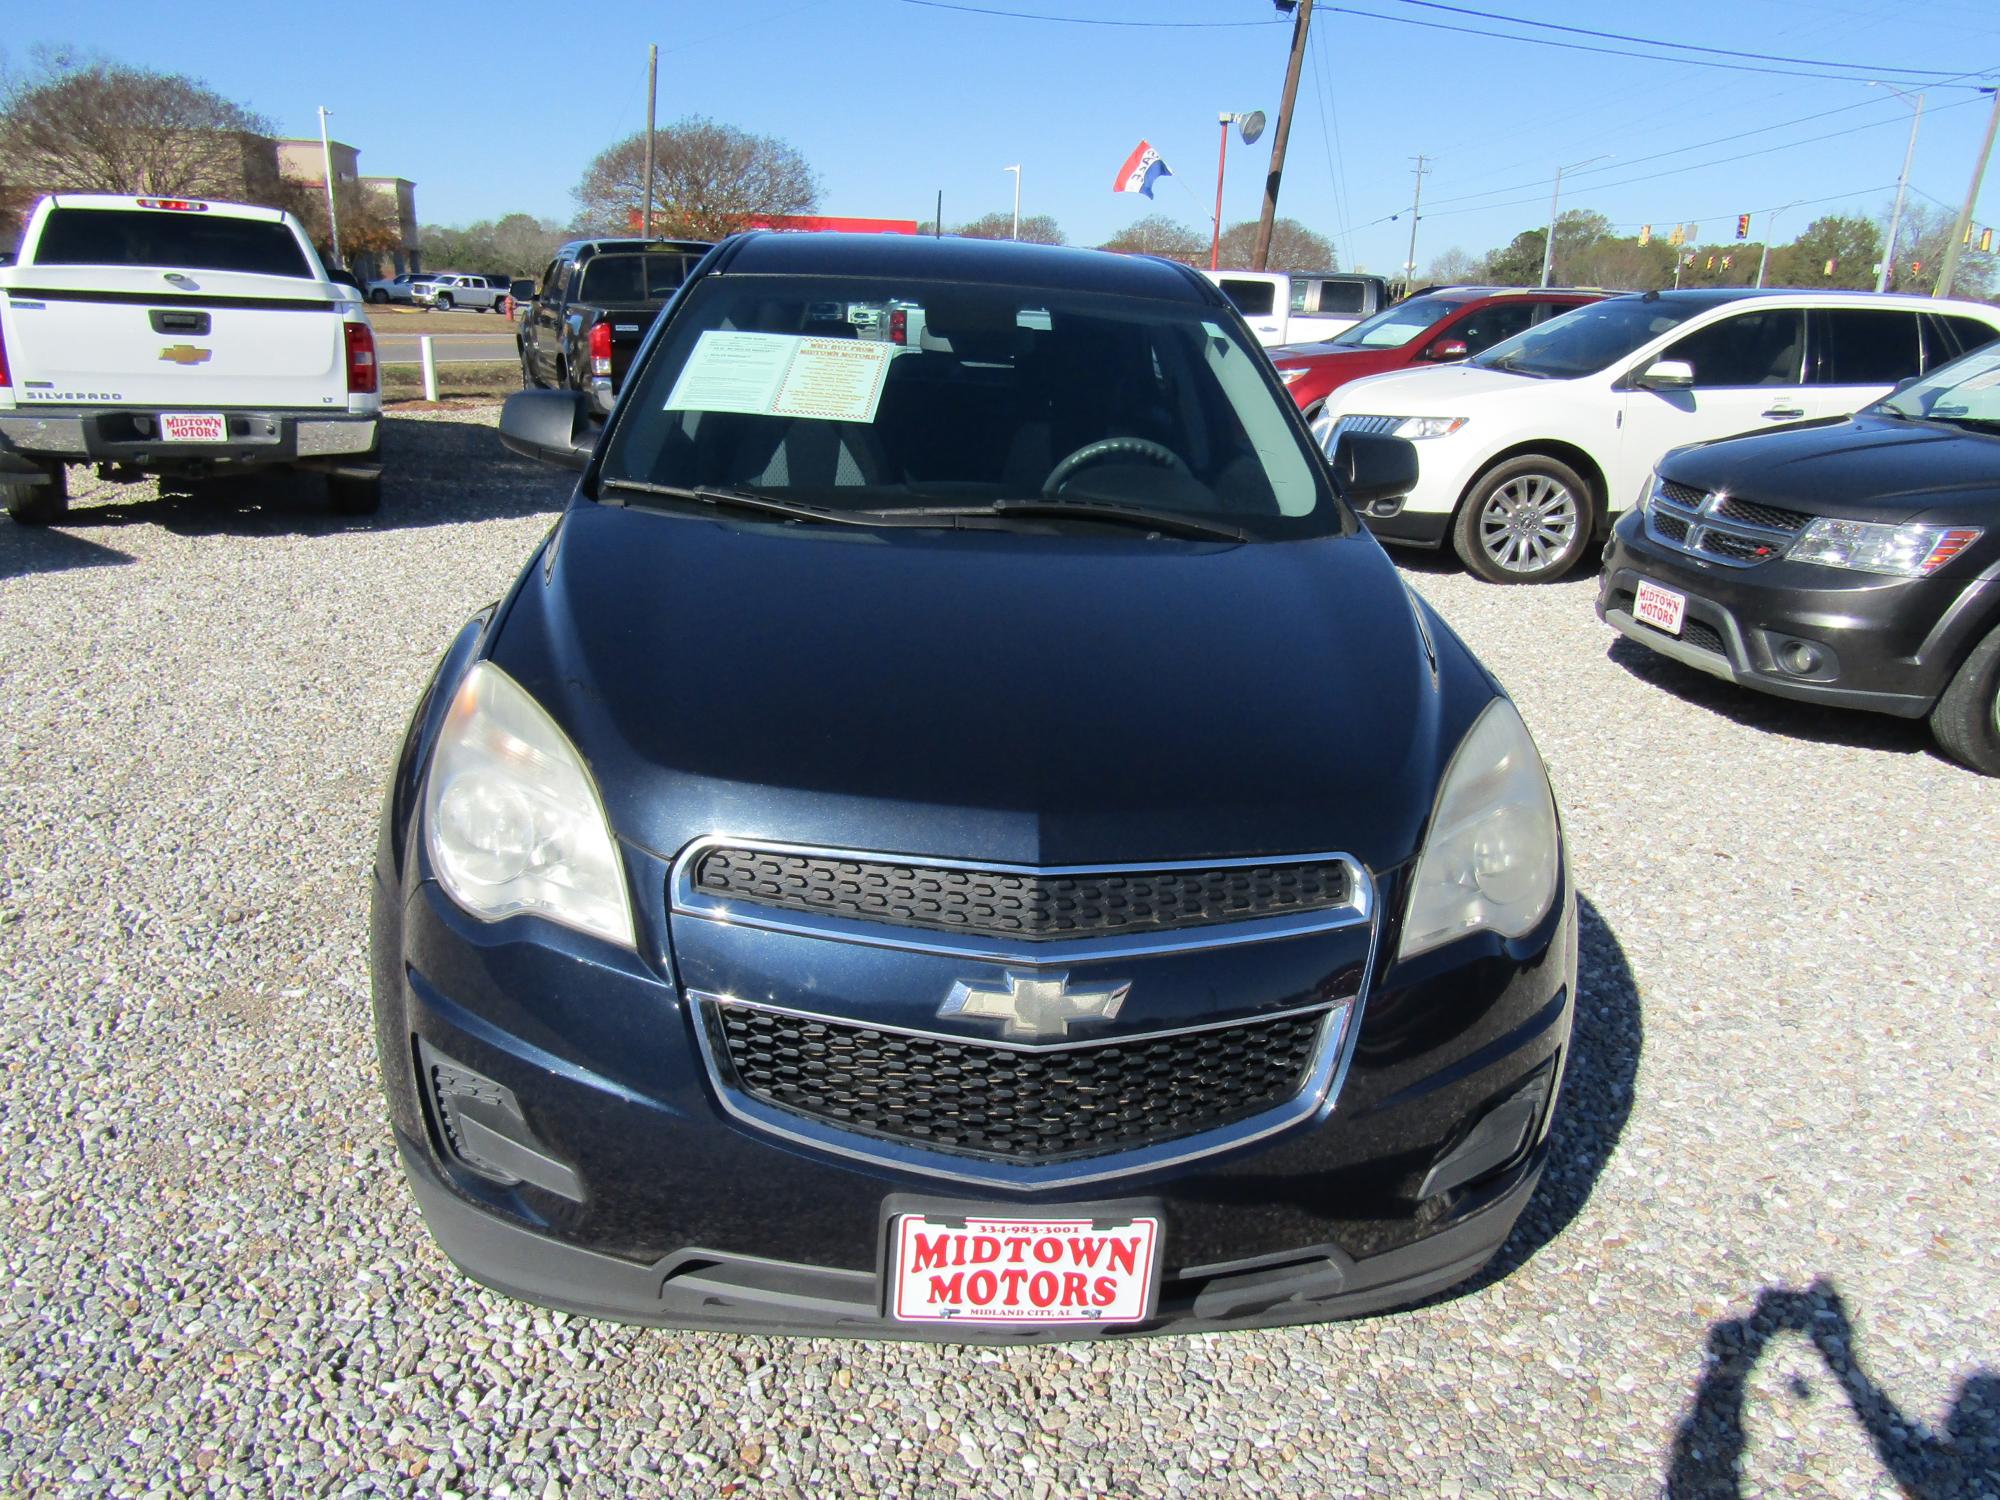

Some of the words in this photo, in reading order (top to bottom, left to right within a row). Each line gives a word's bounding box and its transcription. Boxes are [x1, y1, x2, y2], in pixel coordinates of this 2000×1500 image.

[26, 392, 123, 401] SILVERADO
[166, 417, 222, 429] MIDTOWN
[172, 427, 219, 438] MOTORS
[1638, 588, 1680, 616] MIDTOWN
[1639, 602, 1674, 625] MOTORS
[979, 1225, 1080, 1235] 334-983-3001
[910, 1233, 1141, 1276] MIDTOWN
[926, 1269, 1118, 1307] MOTORS
[970, 1308, 1025, 1317] MIDLAND
[1027, 1309, 1055, 1318] CITY,
[1058, 1309, 1072, 1317] AL
